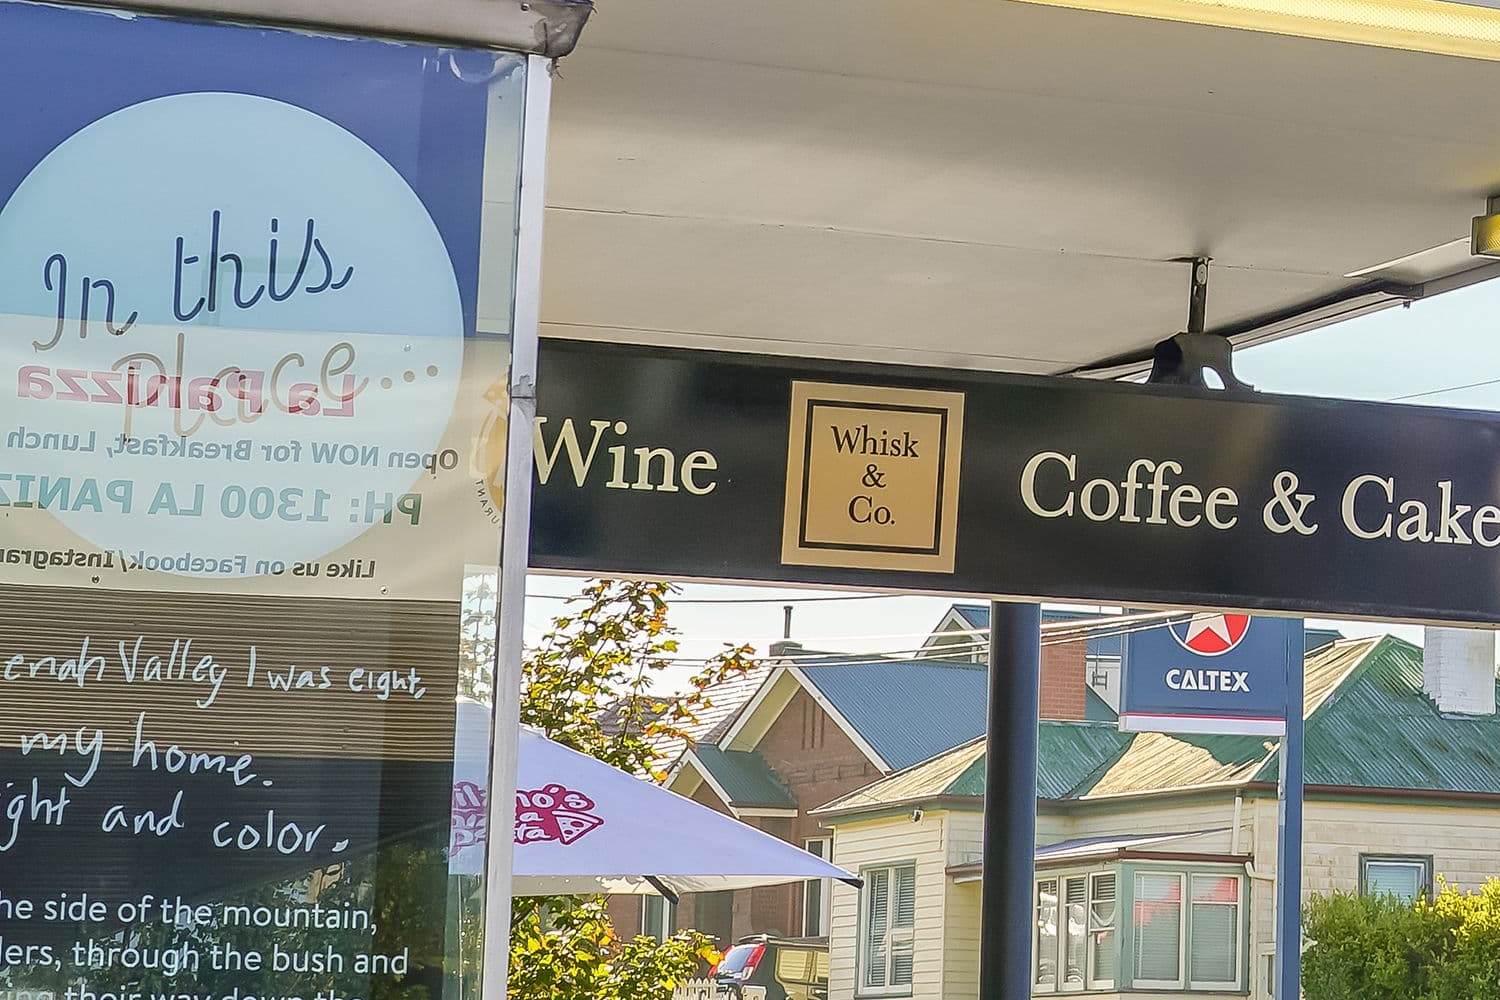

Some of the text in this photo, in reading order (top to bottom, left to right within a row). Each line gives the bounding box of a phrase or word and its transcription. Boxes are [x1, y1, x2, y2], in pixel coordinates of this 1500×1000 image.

[33, 210, 355, 351] In this
[532, 416, 719, 496] Wine
[830, 423, 920, 460] Whisk
[860, 462, 887, 489] &
[1019, 451, 1240, 531] Coffee
[1262, 470, 1319, 536] &
[847, 494, 897, 526] Co.
[119, 636, 228, 708] Valley
[247, 645, 257, 688] I
[267, 664, 333, 692] was
[349, 667, 428, 700] eight,
[1165, 668, 1251, 693] CALTEX
[21, 711, 274, 788] my home.
[0, 776, 71, 851] ght
[102, 789, 185, 837] and
[44, 893, 107, 922] side
[117, 895, 154, 923] of
[160, 896, 213, 926] the
[223, 902, 378, 936] mountain,
[72, 938, 200, 977] through
[210, 943, 262, 971] the
[272, 943, 344, 974] bush
[354, 947, 409, 975] and
